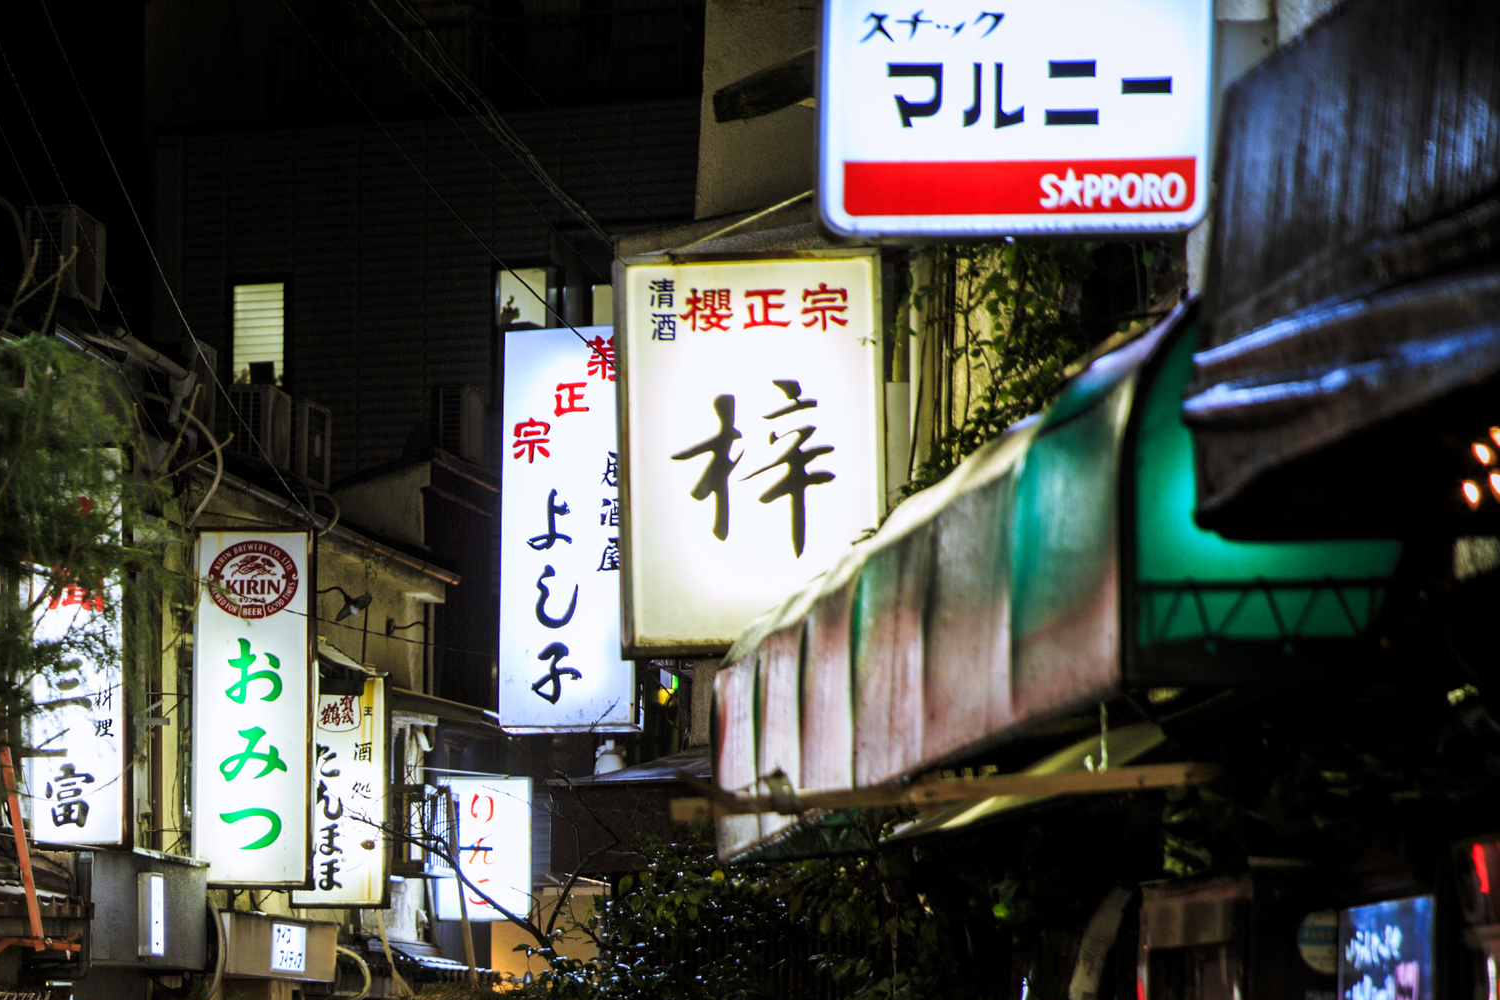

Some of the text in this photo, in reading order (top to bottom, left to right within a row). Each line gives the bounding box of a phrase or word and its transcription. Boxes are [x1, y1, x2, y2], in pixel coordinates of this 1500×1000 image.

[858, 10, 1006, 44] スナック
[886, 60, 1174, 130] マルニー
[648, 279, 676, 342] 清酒
[671, 379, 836, 559] 梓
[233, 543, 269, 555] BREWERY
[225, 579, 281, 596] KIRIN
[242, 607, 263, 616] BEER
[526, 487, 583, 704] よし子
[218, 637, 288, 850] おみつ
[351, 741, 373, 800] 酒処
